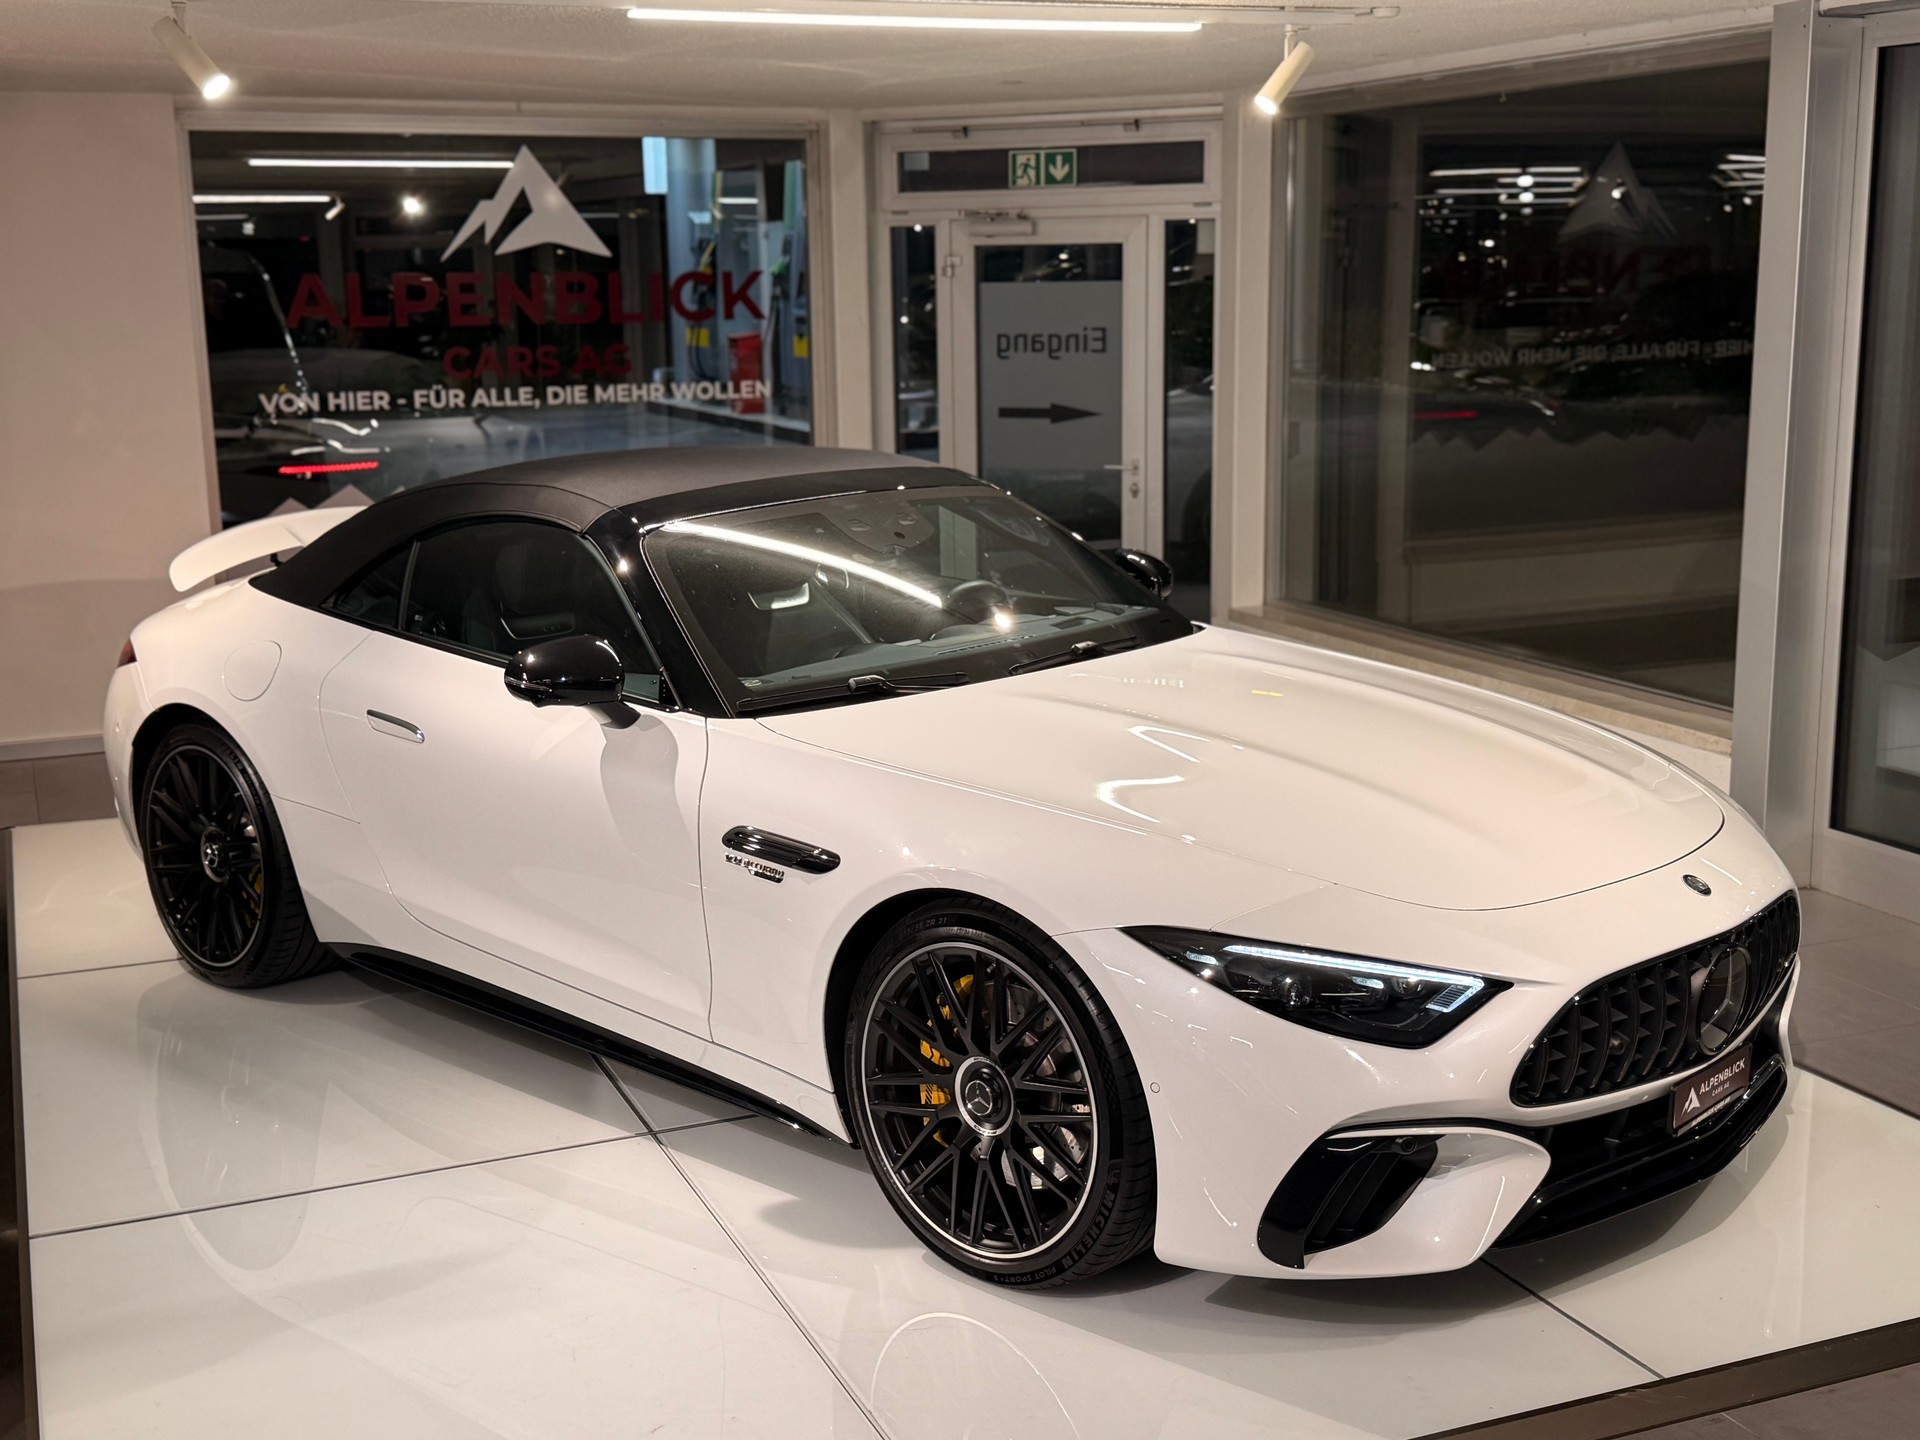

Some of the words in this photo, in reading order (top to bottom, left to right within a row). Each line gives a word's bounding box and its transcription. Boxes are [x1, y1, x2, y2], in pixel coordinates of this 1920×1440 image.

[287, 270, 765, 329] ALPENBLICK
[443, 345, 561, 379] CARS
[574, 343, 633, 377] AG
[258, 391, 321, 414] VON
[327, 389, 391, 413] HIER
[413, 383, 466, 410] FÜR
[471, 385, 541, 410] ALLE,
[546, 383, 588, 406] DIE
[594, 381, 664, 404] MEHR
[670, 379, 771, 402] WOLLEN
[1699, 1057, 1745, 1095] ALPENBLICK
[1062, 1186, 1116, 1268] MICHELIN
